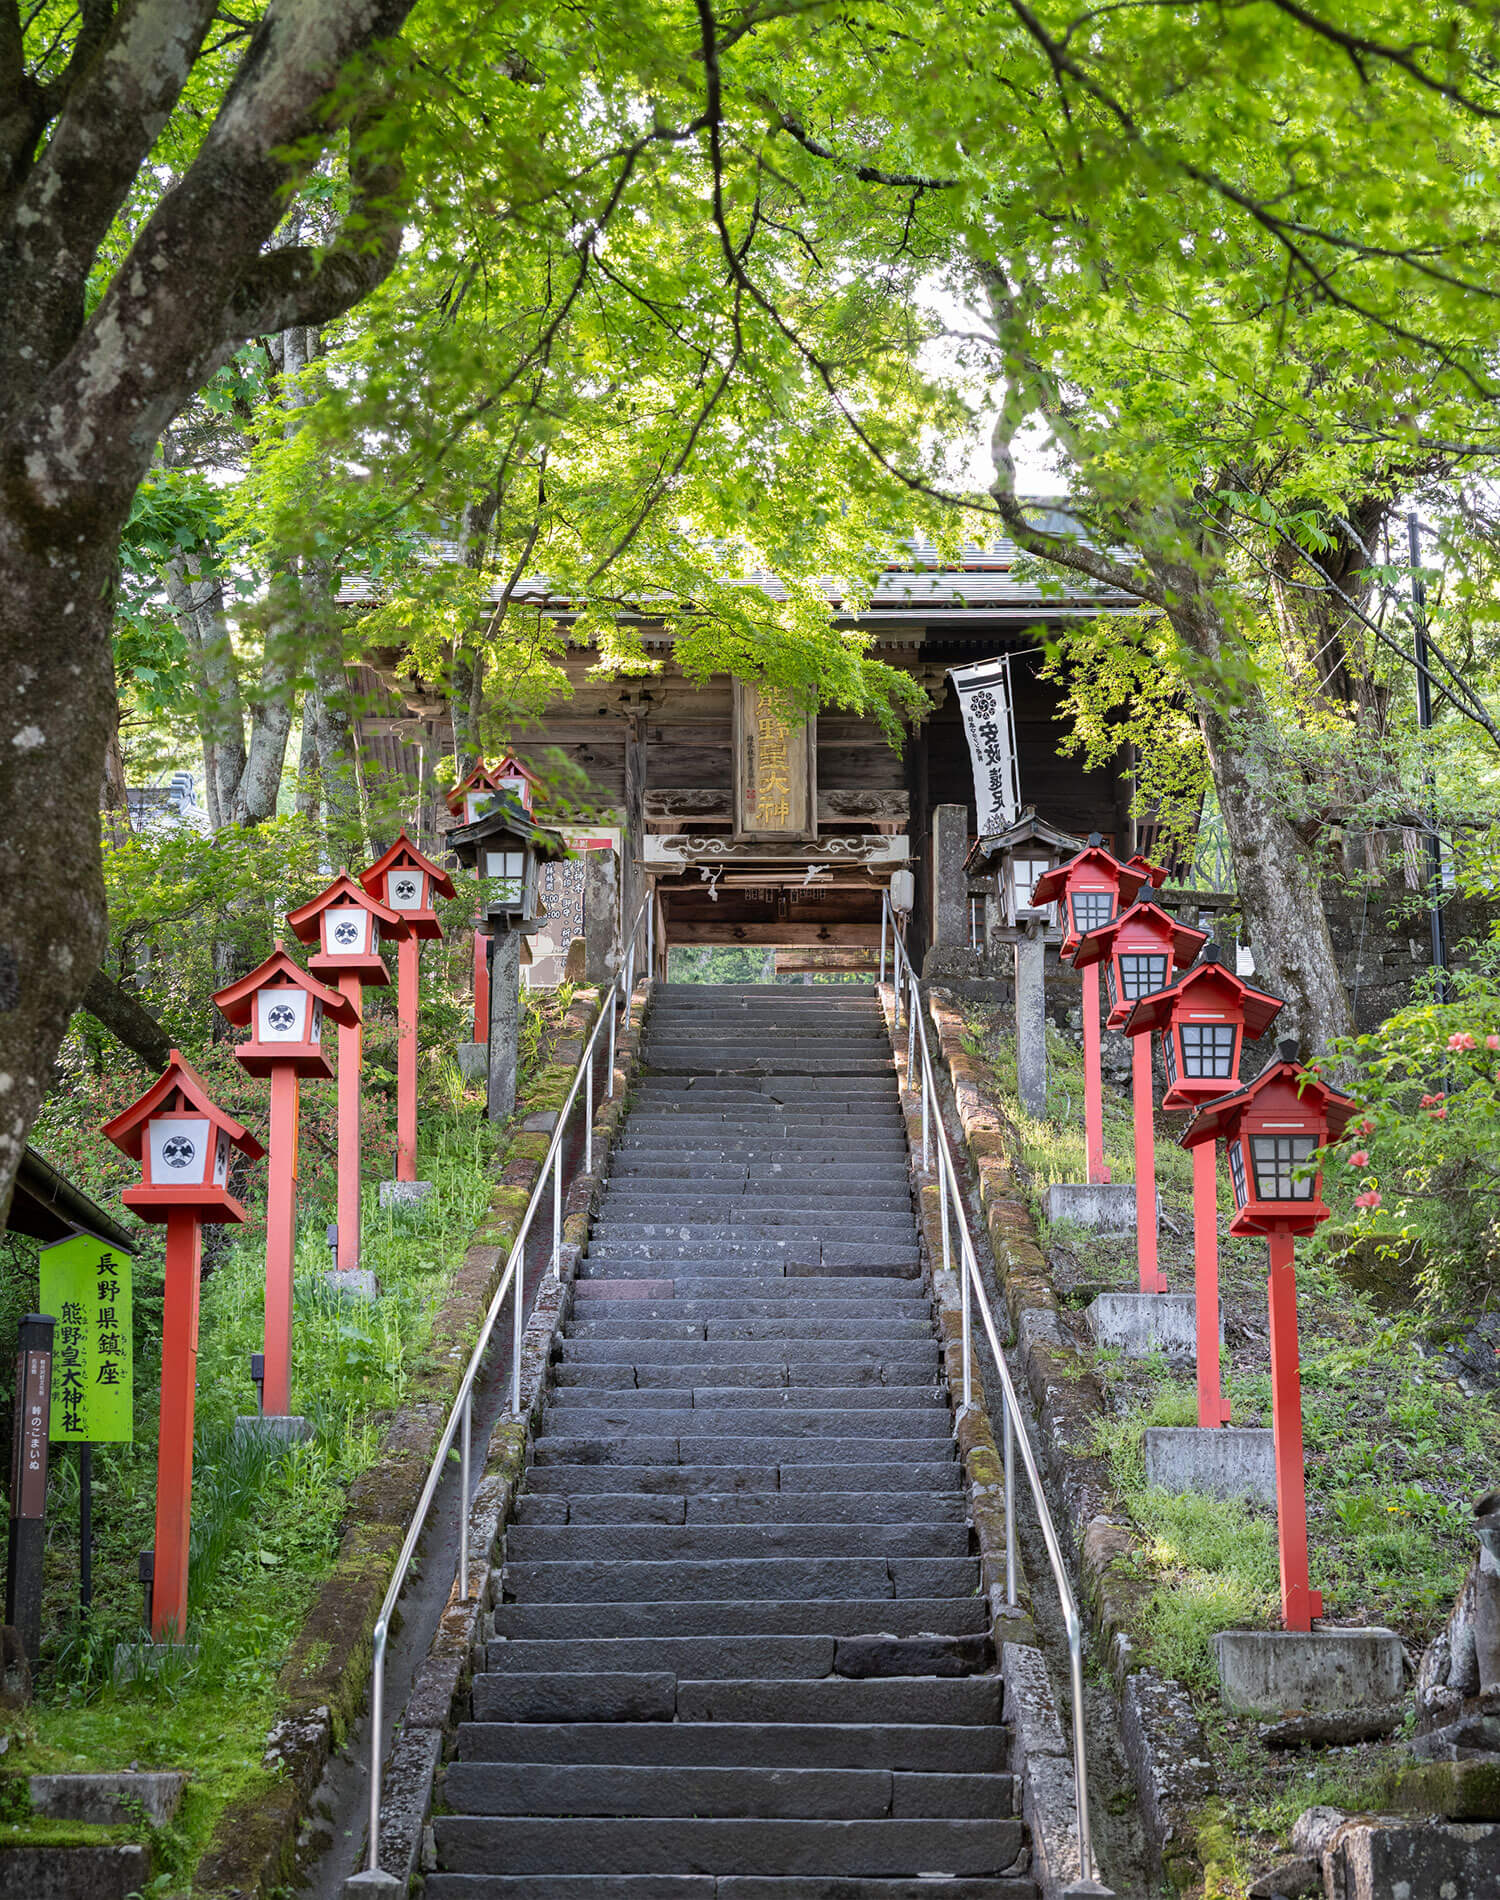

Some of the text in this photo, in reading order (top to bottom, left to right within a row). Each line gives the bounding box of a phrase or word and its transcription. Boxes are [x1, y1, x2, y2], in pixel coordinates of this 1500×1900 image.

[60, 1301, 84, 1433] 熊野皇大神社
[95, 1252, 121, 1385] 長野県鎮座
[29, 1406, 42, 1470] 峠のこまいぬ
